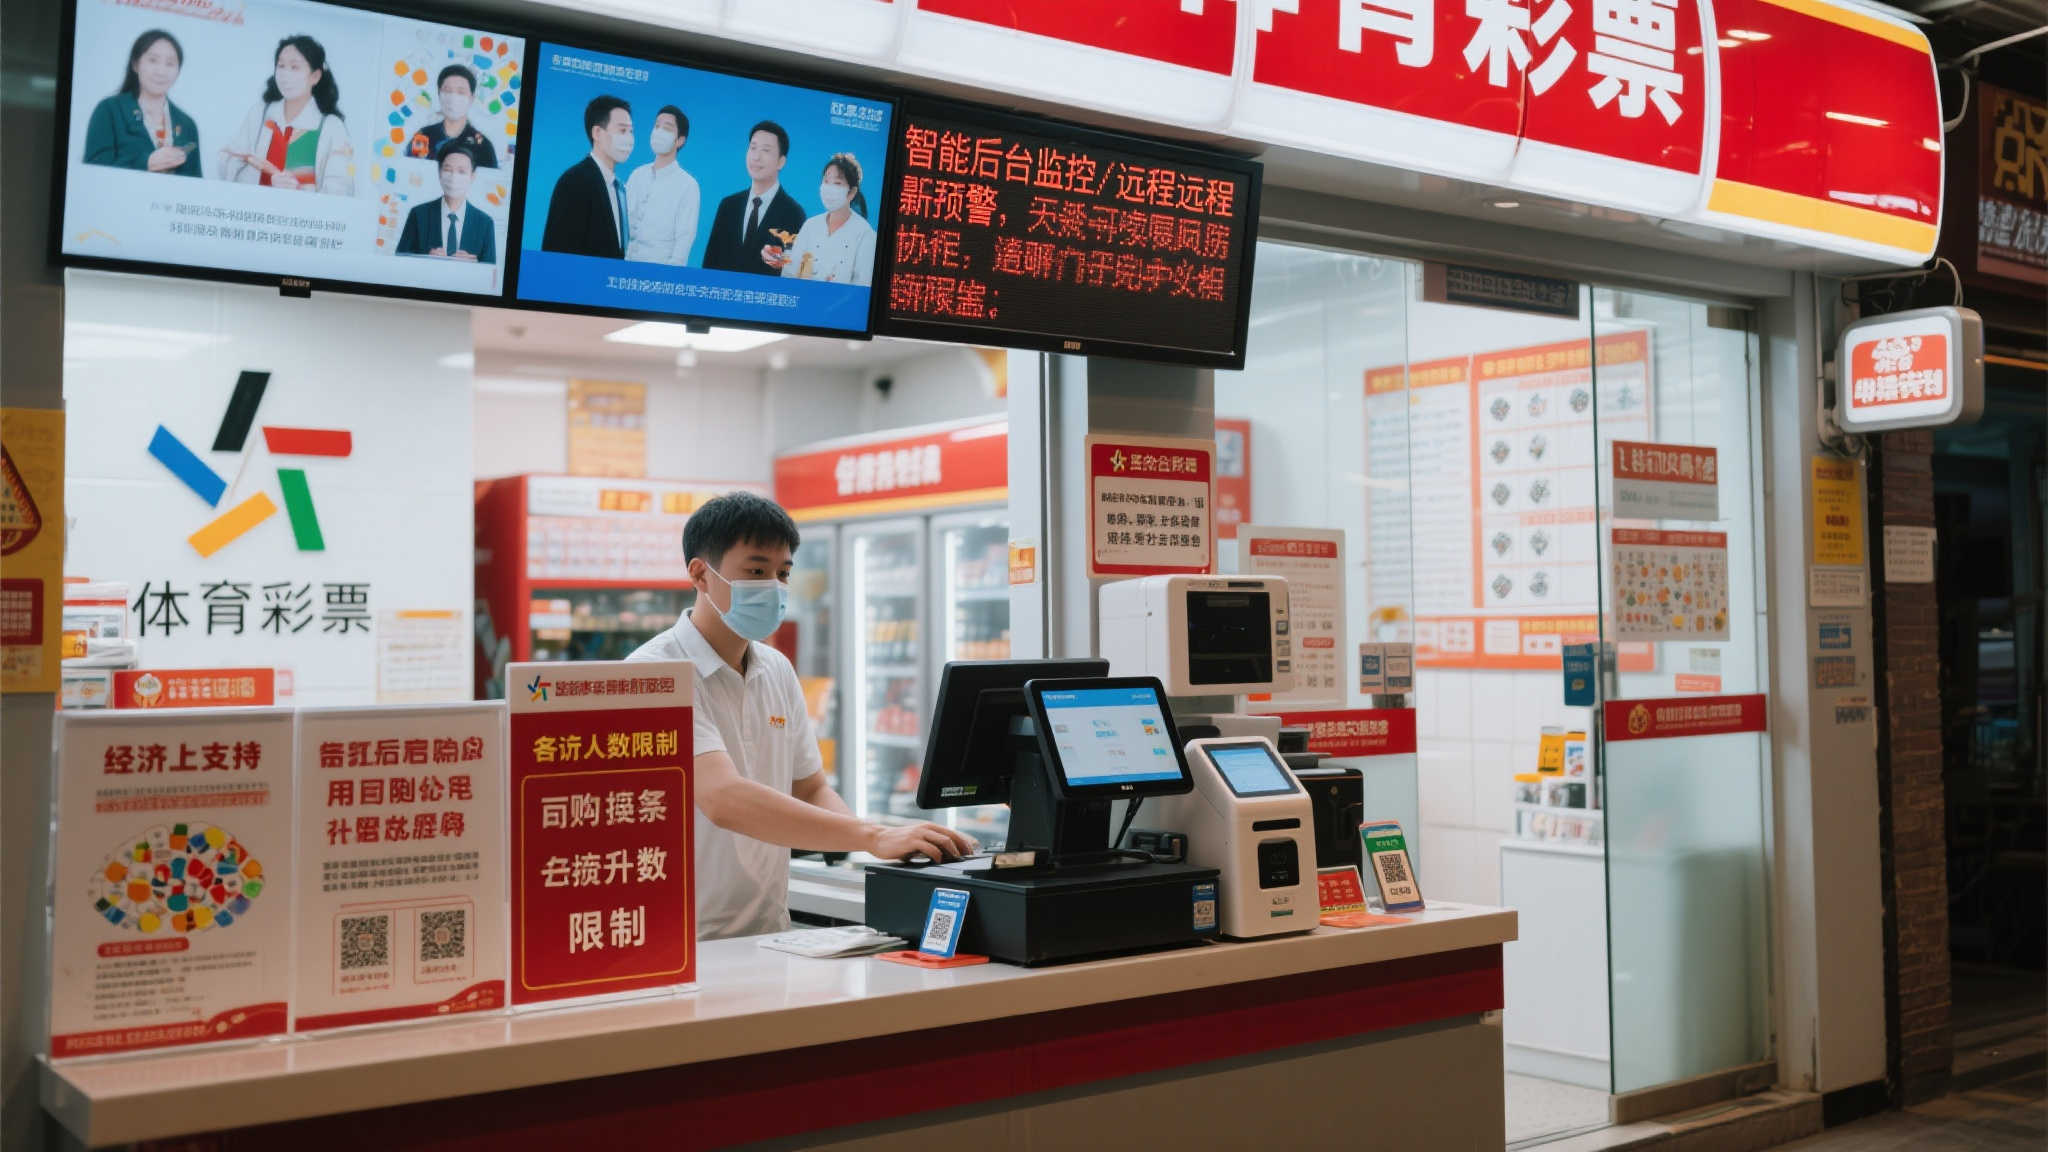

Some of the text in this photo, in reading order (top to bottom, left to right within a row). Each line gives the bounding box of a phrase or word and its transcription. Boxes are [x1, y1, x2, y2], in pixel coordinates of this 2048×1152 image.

[905, 123, 1235, 217] 智能后台监控/远程远程
[132, 579, 372, 637] 体育彩票
[104, 741, 262, 774] 经济上支持
[568, 905, 647, 954] 限制
